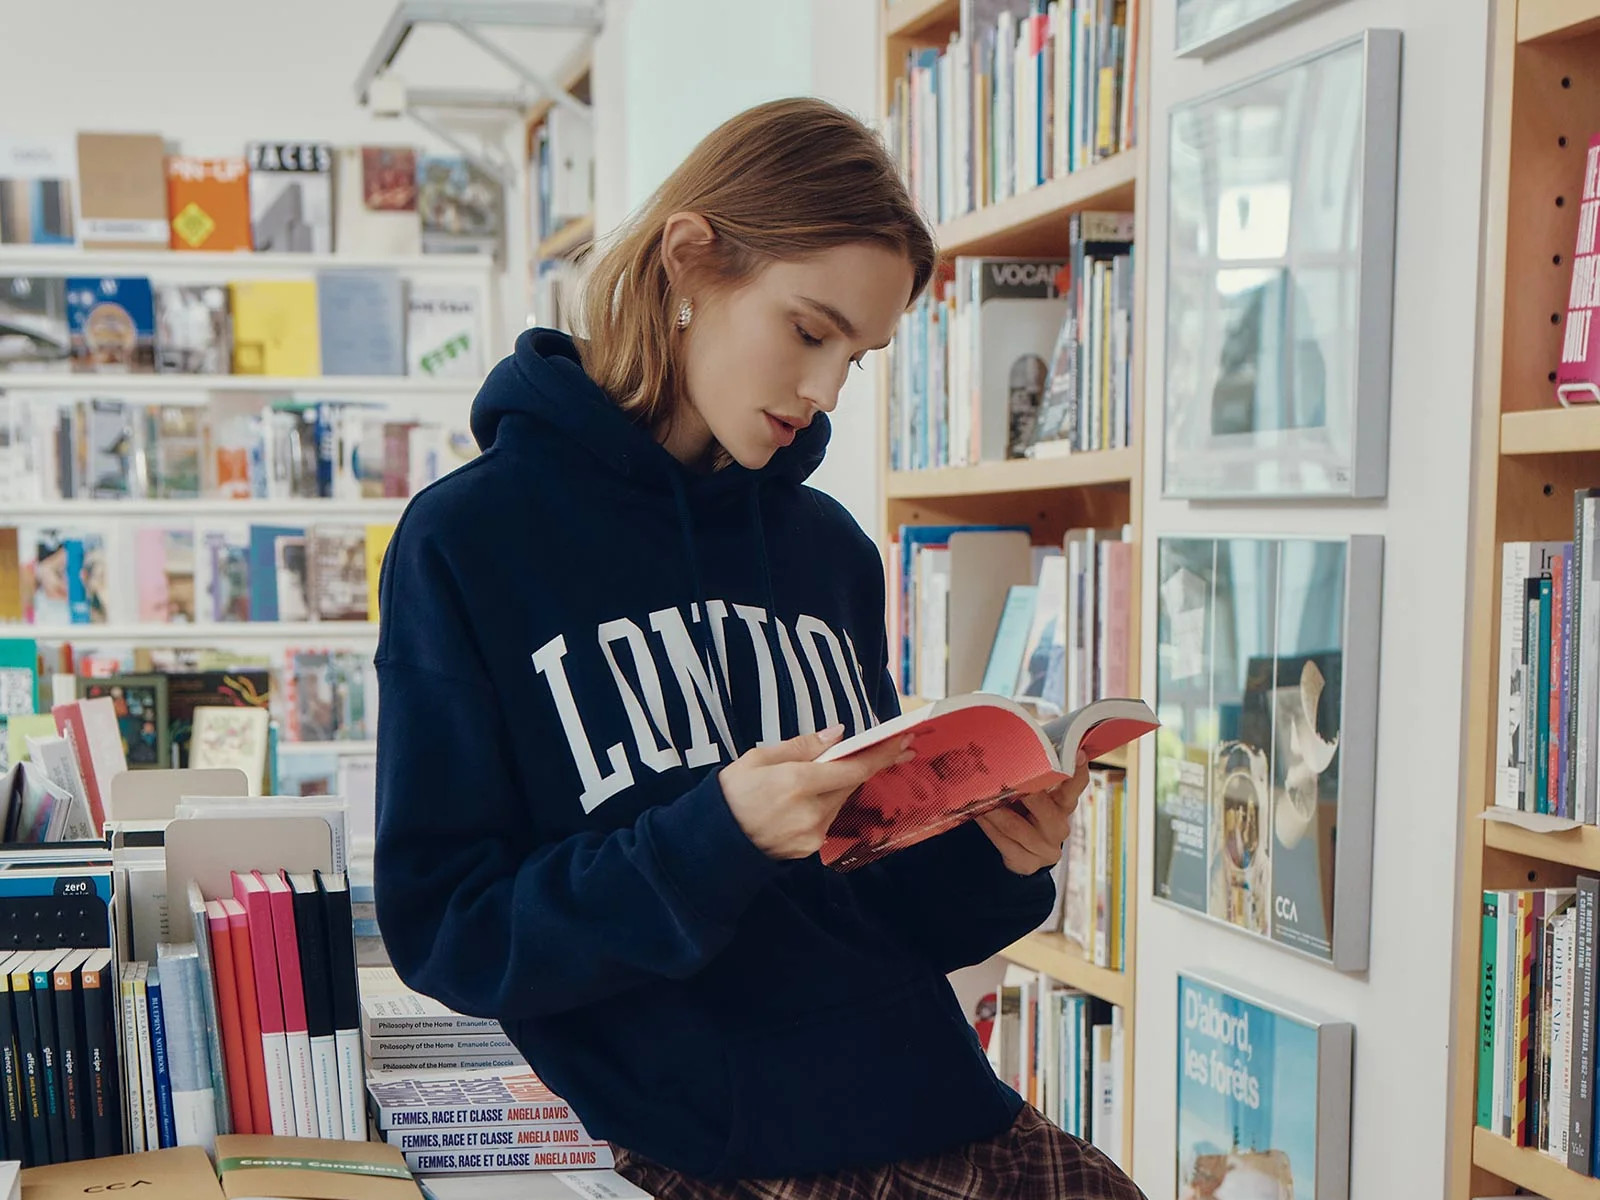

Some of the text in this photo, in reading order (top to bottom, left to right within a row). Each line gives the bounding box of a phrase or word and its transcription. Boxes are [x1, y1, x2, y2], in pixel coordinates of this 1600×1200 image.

[1275, 895, 1298, 923] CCA
[1583, 945, 1592, 1007] ARCHITECTURE
[151, 997, 161, 1035] BLUEPRINT
[1483, 962, 1493, 1053] MODEL
[1185, 987, 1253, 1061] D'abord,
[42, 1047, 53, 1067] glass
[155, 1037, 165, 1075] NOTEBOOK
[379, 1043, 415, 1051] Philosophy
[3, 1047, 13, 1074] silence
[26, 1052, 35, 1075] office
[65, 1050, 74, 1074] recipe
[93, 1048, 102, 1072] recipe
[460, 1060, 492, 1068] Emanuele
[1184, 1037, 1260, 1110] les forêts
[392, 1106, 569, 1126] FEMMES, RACE ET CLASSE ANGELA DAVIS
[402, 1129, 579, 1149] FEMMES, RACE ET CLASSE ANGELA DAVIS
[239, 1158, 400, 1174] Centre Canadien
[418, 1151, 596, 1169] FEMMES, RACE ET CLASSE ANGELA DAVIS
[83, 1179, 153, 1194] CCA
